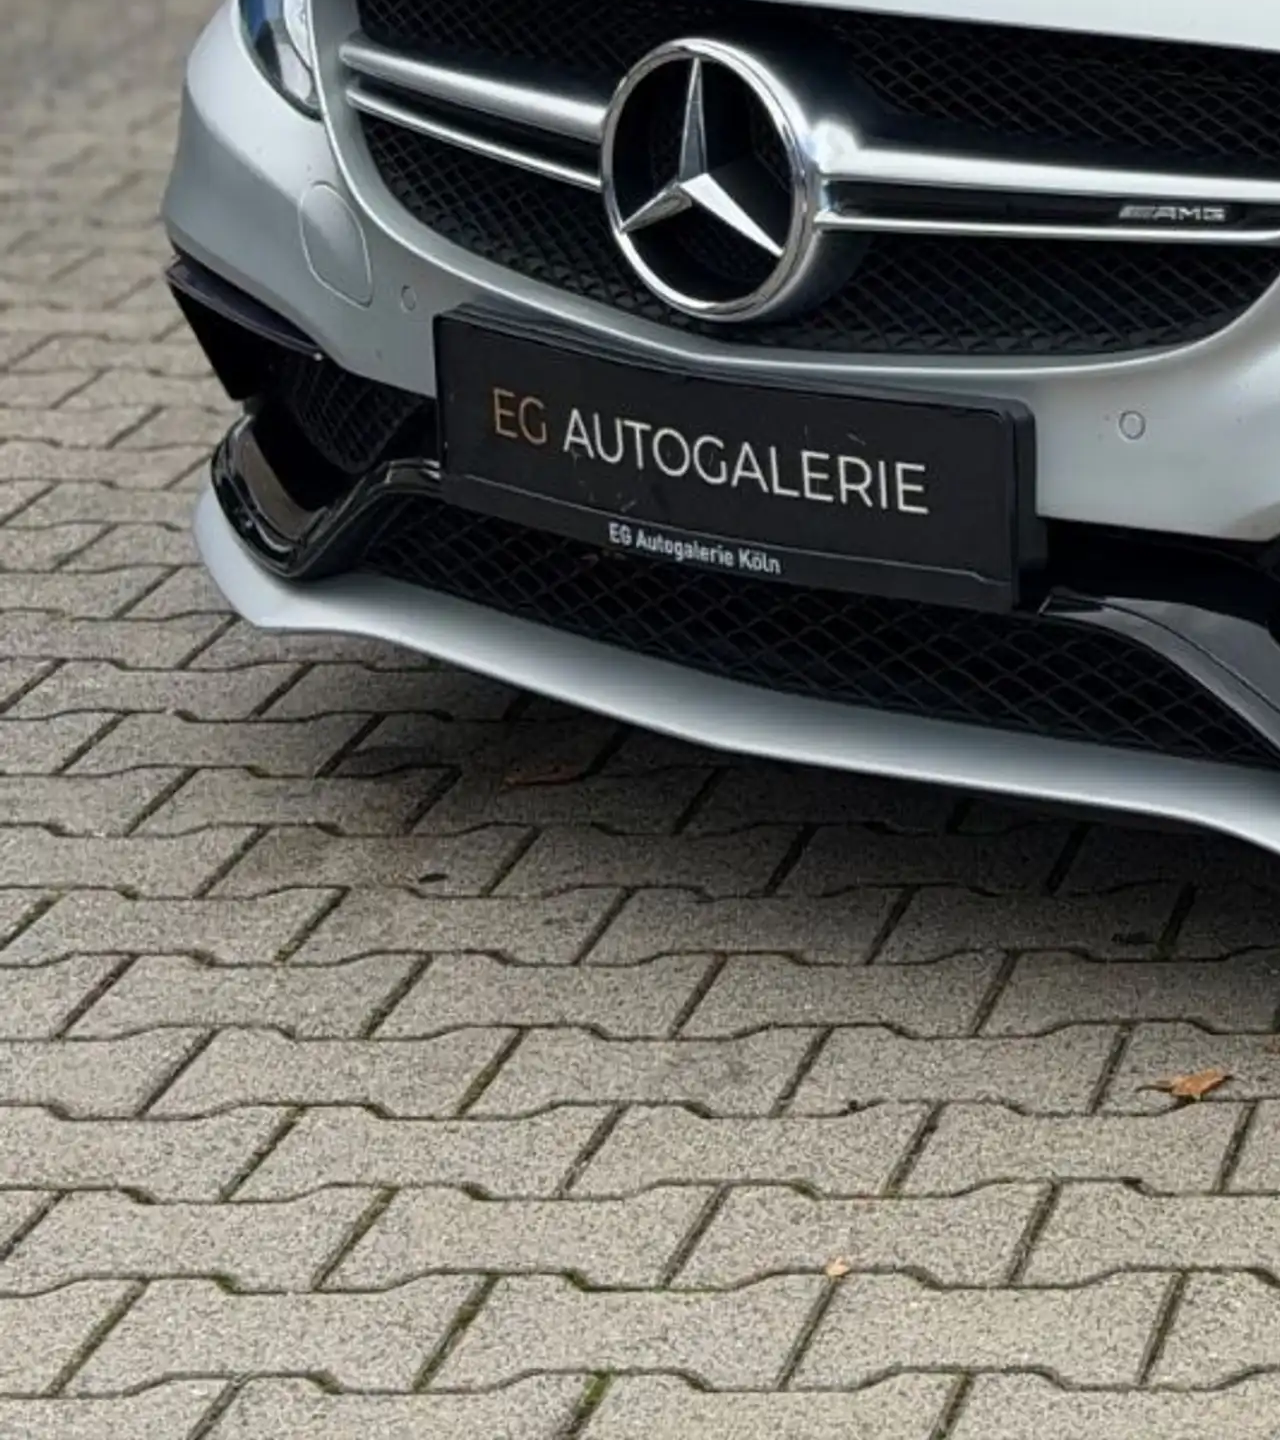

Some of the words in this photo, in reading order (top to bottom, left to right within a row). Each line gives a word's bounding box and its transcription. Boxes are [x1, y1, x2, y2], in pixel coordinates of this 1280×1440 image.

[1146, 206, 1225, 222] AMG
[493, 388, 548, 445] EG
[563, 408, 930, 515] AUTOGALERIE
[608, 521, 632, 546] EG
[635, 529, 735, 567] Autogalerie
[738, 547, 781, 575] Köln
